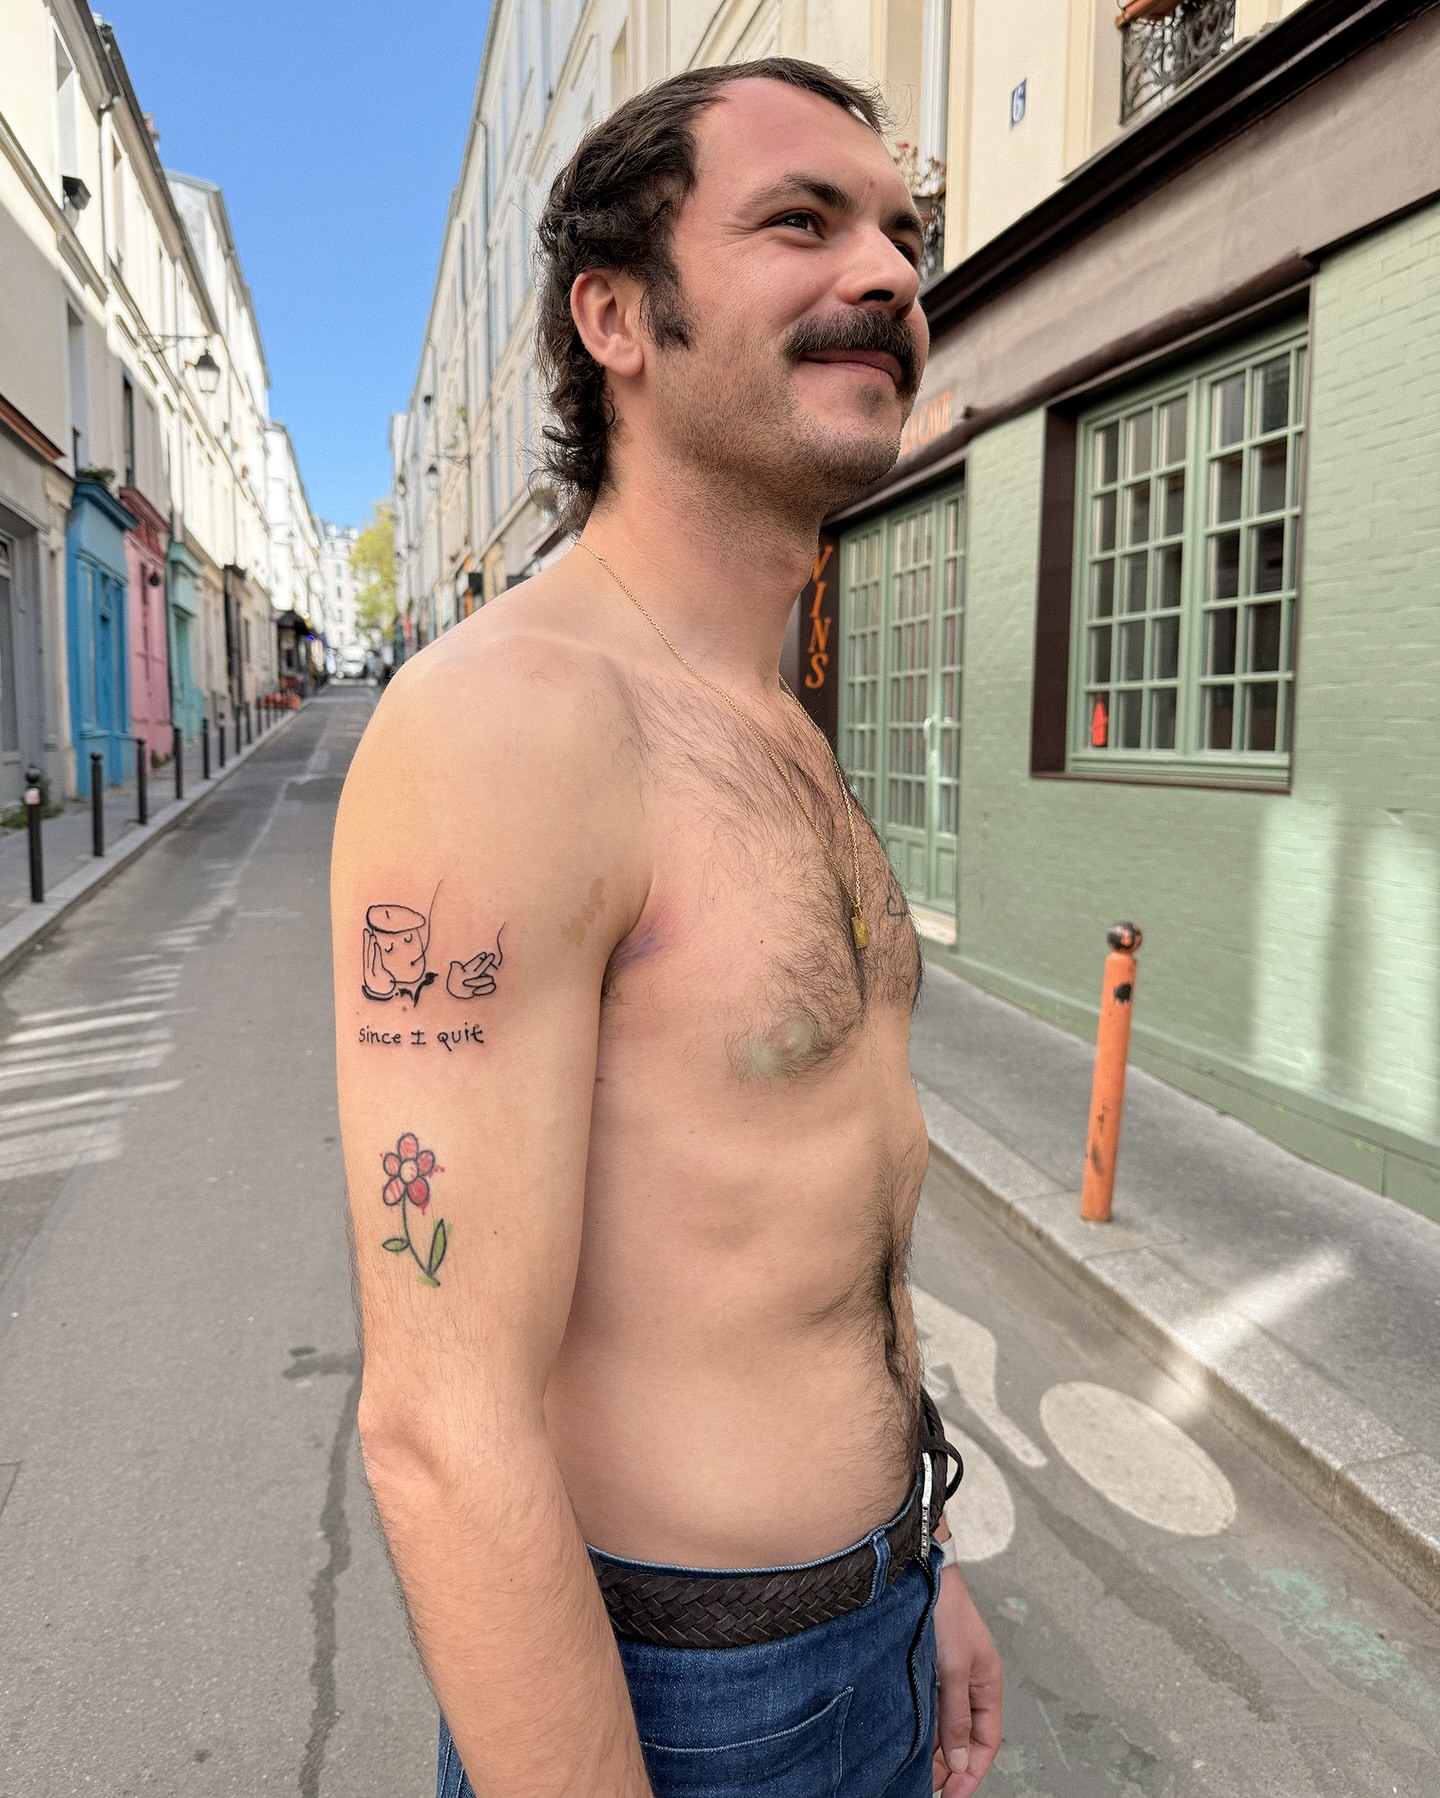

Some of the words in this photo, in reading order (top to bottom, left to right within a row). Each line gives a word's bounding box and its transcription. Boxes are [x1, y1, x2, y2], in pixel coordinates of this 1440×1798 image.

[1012, 82, 1025, 122] 6
[805, 545, 833, 689] VINS
[411, 1029, 427, 1045] I
[437, 1021, 485, 1052] quit
